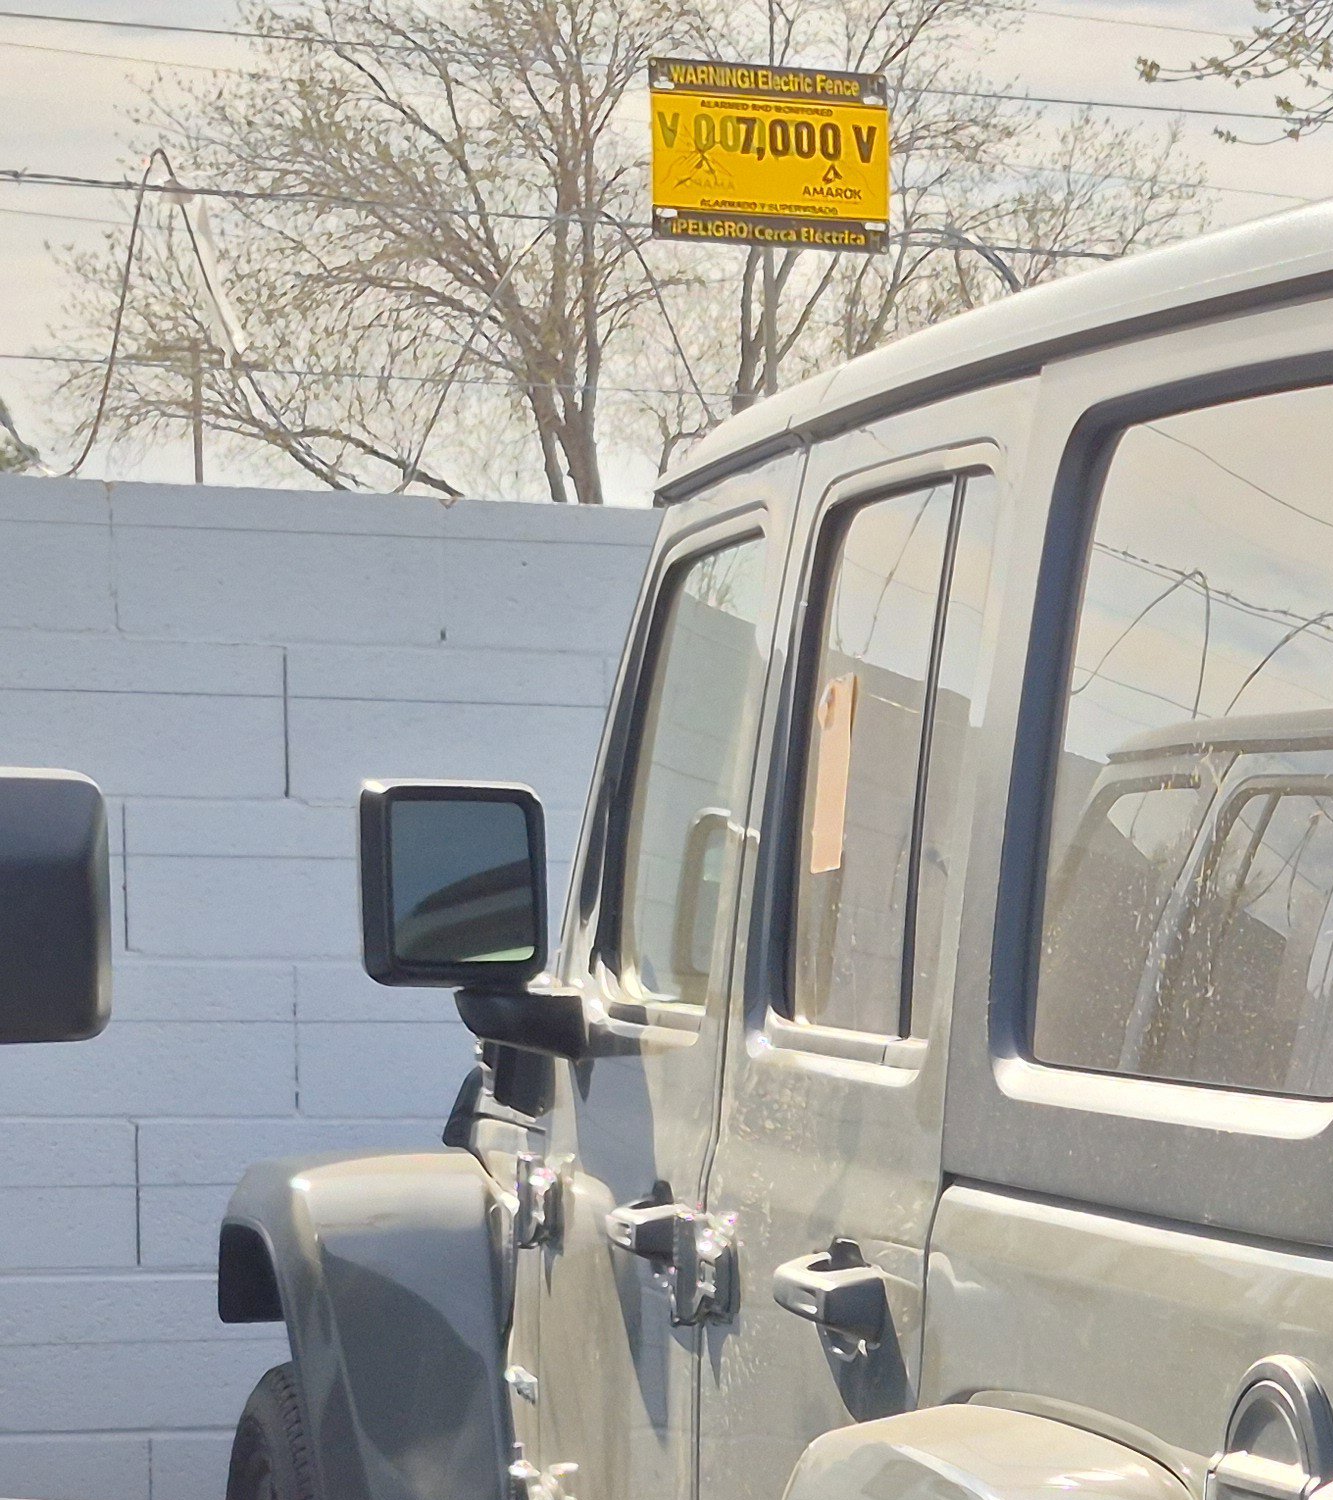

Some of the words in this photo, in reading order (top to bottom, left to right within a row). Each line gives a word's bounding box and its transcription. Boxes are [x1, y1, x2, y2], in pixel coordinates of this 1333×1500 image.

[669, 62, 756, 91] WARNING!
[757, 71, 814, 93] Electric
[815, 74, 861, 97] Fence
[802, 185, 862, 200] AMAROK
[754, 224, 797, 243] Cerca
